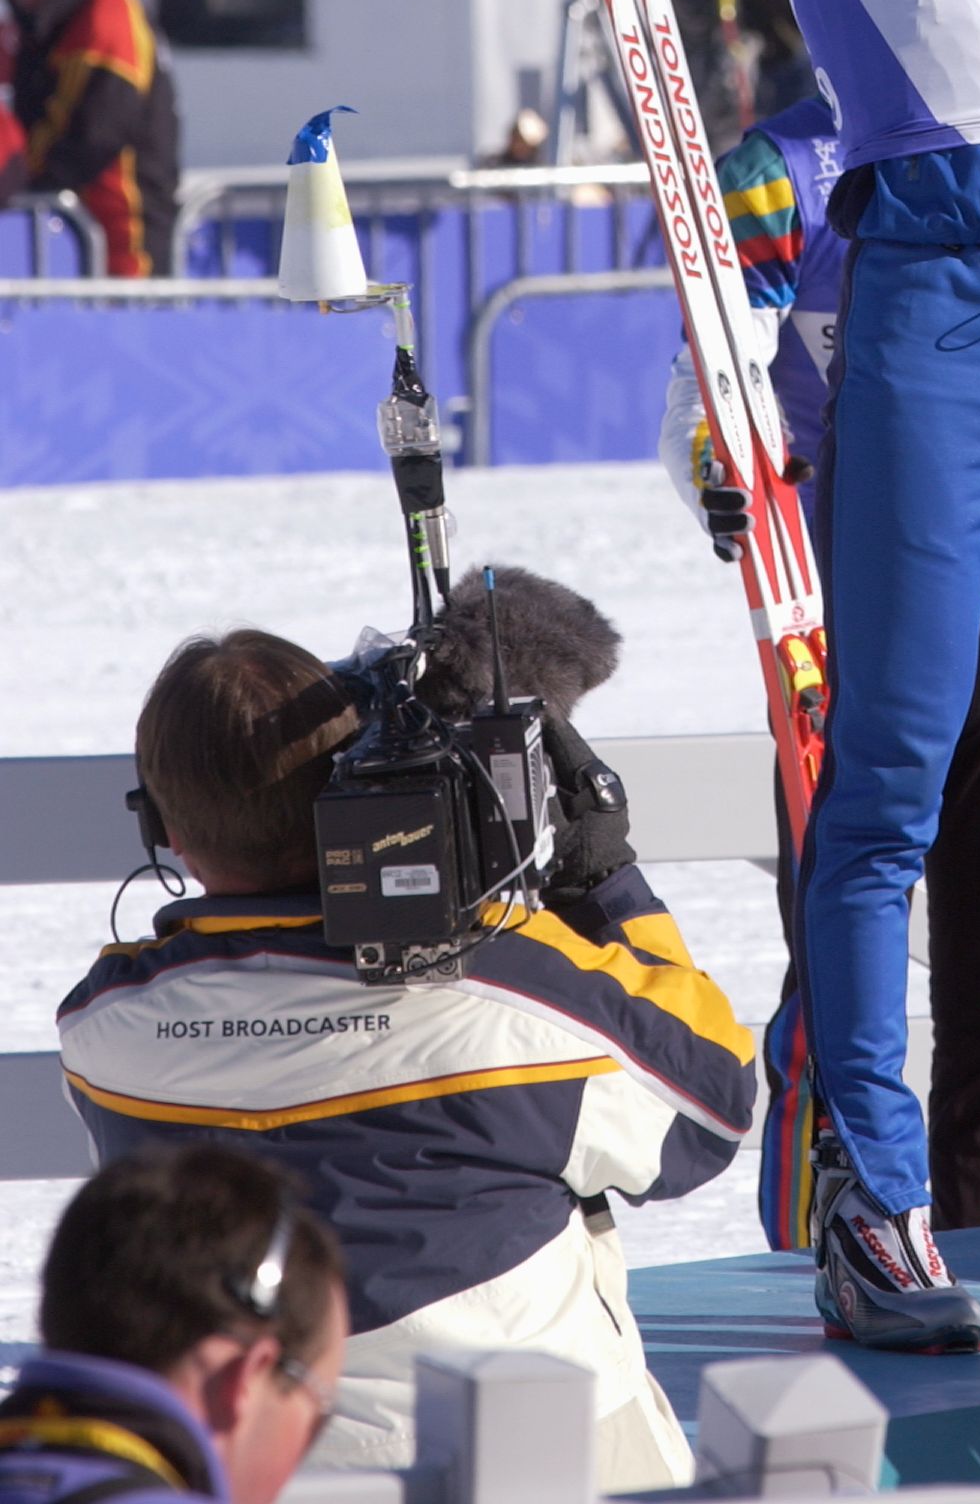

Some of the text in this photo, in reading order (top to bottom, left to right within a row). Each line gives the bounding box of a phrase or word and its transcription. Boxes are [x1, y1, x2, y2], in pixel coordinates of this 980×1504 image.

[621, 24, 703, 279] ROSSIGNOL
[654, 13, 734, 269] ROSSIGNOL
[156, 1014, 391, 1039] HOST BROADCASTER
[850, 1215, 913, 1287] ROSSIGNOL
